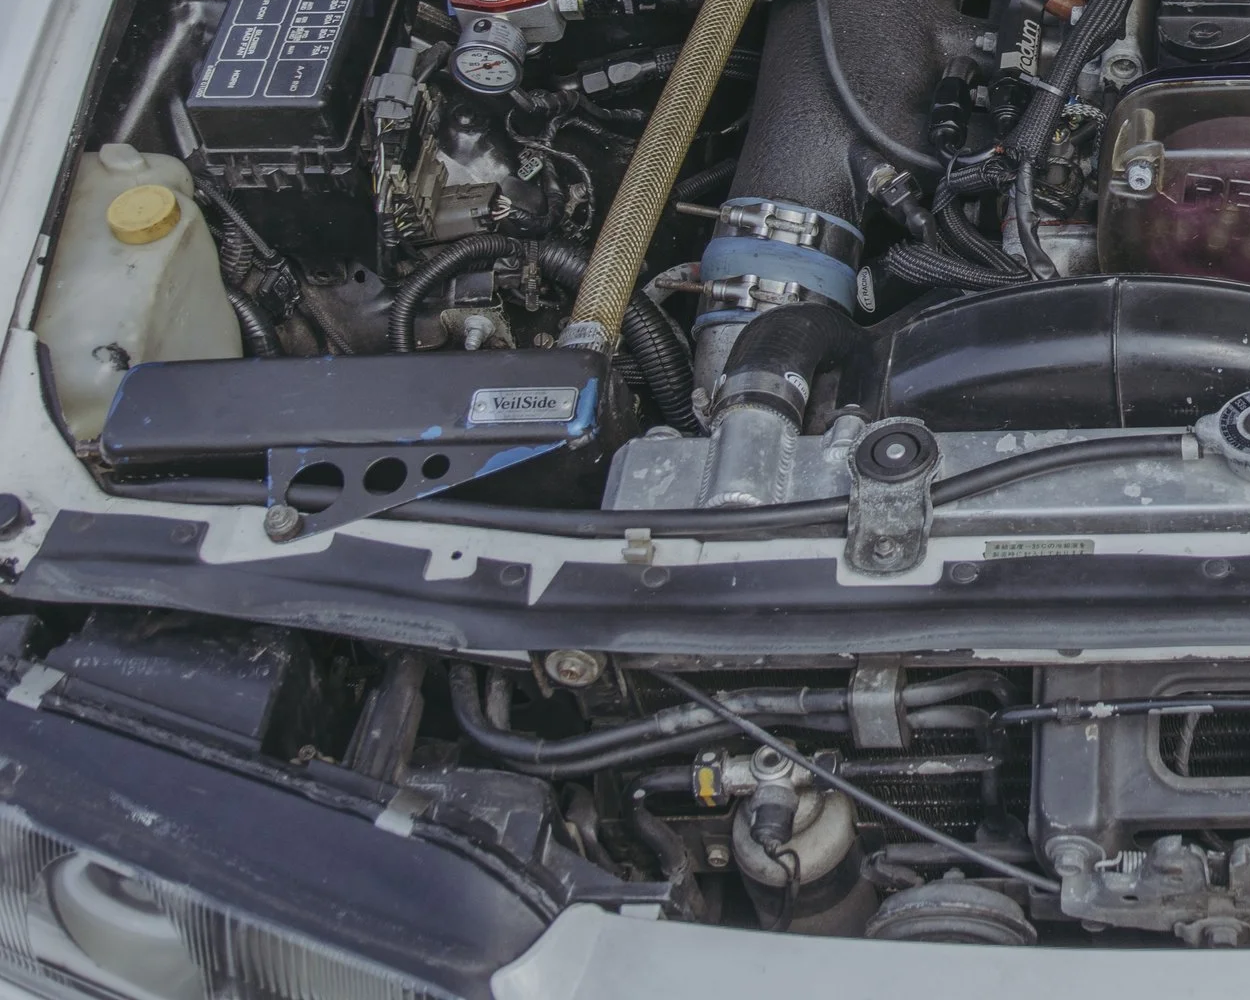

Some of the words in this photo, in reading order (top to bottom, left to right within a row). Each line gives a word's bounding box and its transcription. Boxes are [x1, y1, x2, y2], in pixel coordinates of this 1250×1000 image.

[256, 6, 268, 19] CON
[242, 26, 254, 42] RAD
[236, 42, 248, 55] FAN
[227, 69, 241, 89] HORN
[493, 395, 557, 410] VeilSide
[1220, 406, 1245, 451] PRESSURE
